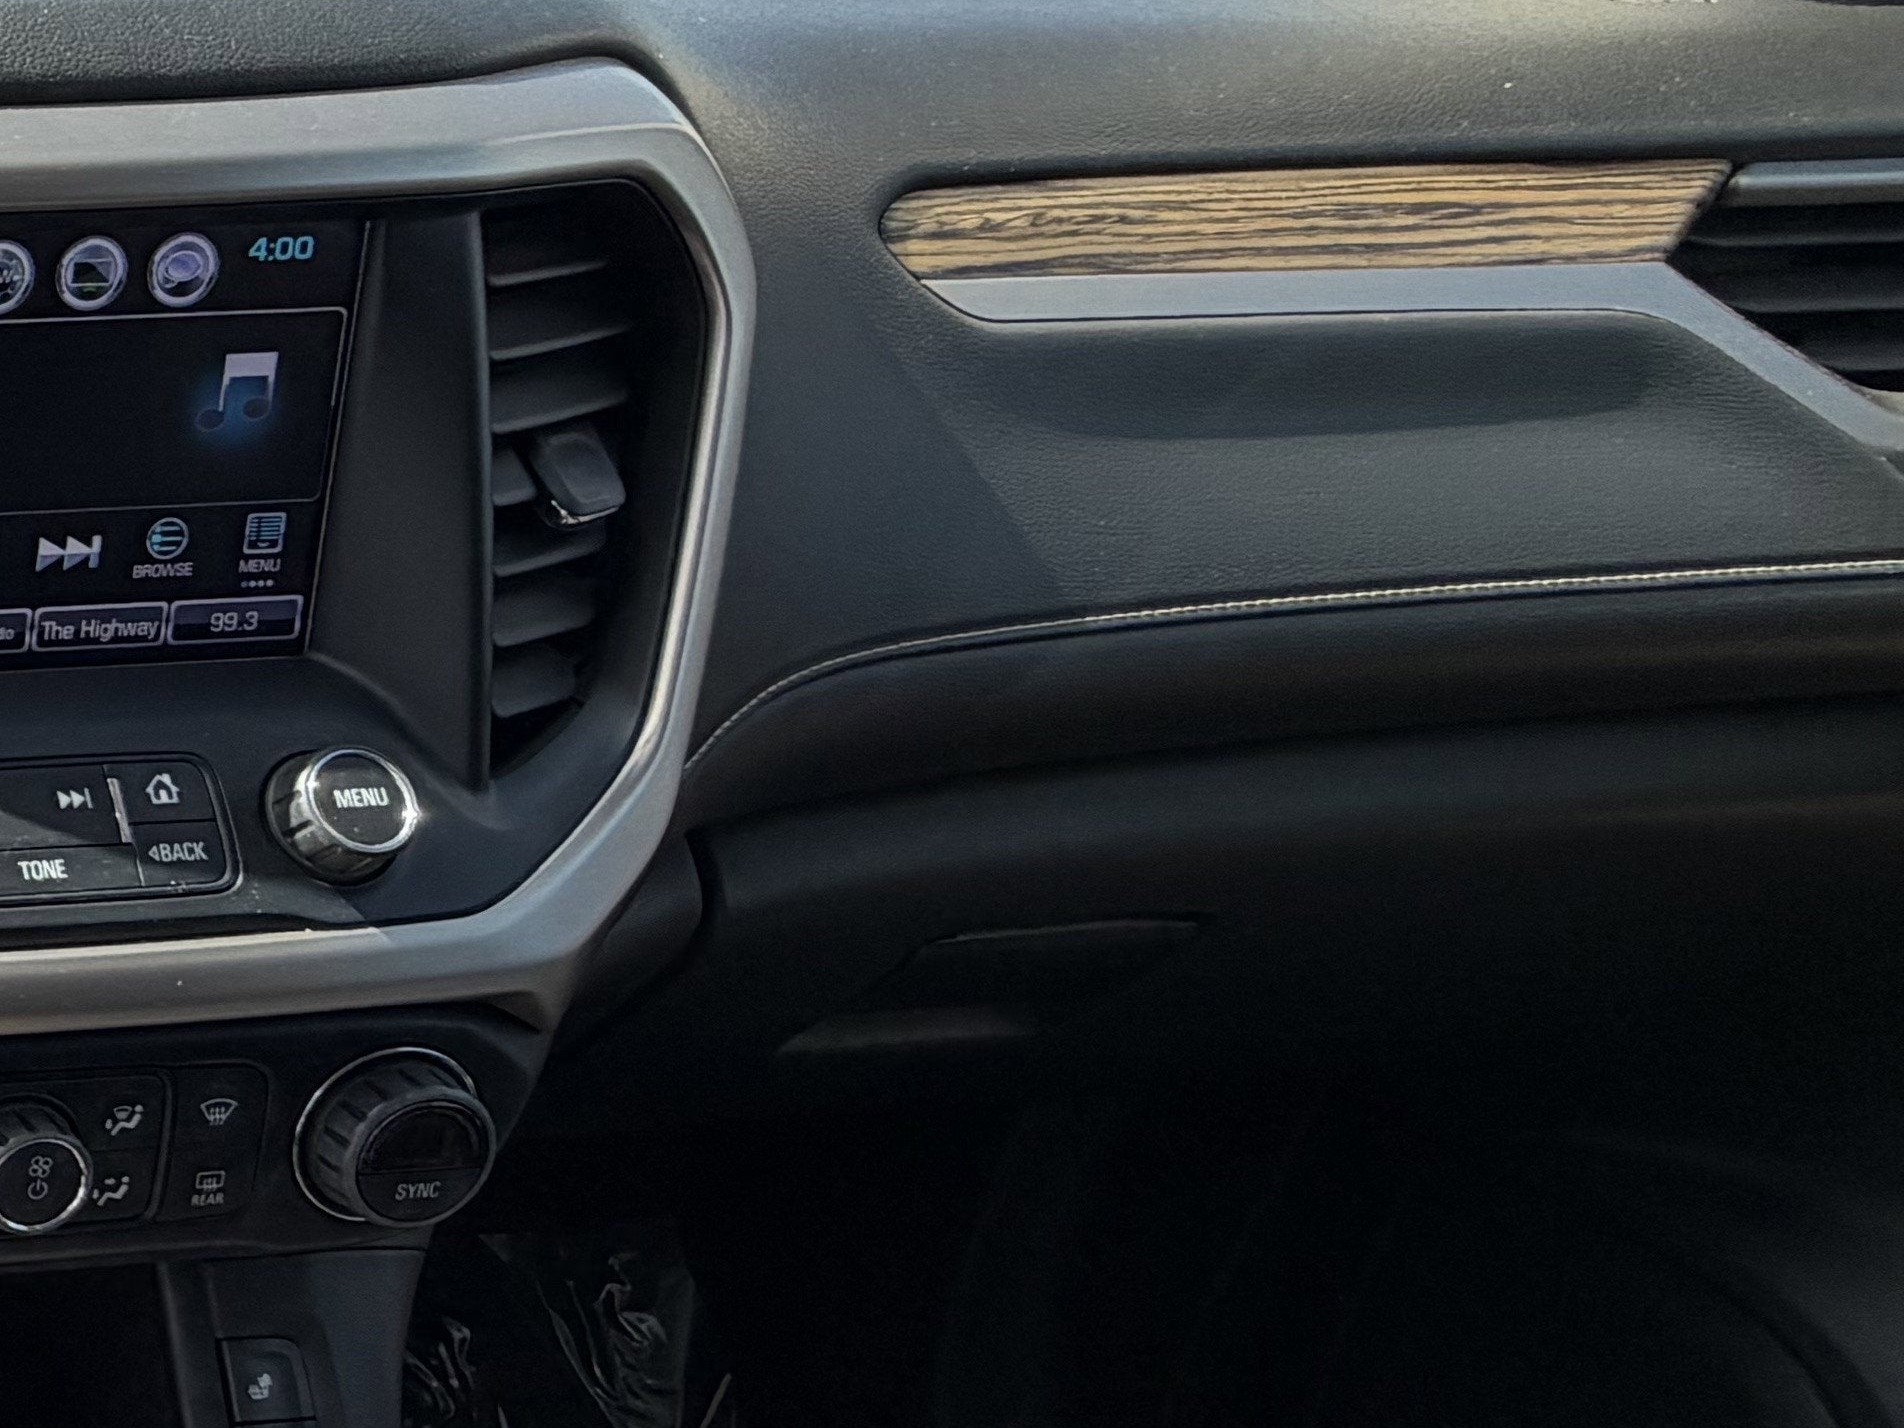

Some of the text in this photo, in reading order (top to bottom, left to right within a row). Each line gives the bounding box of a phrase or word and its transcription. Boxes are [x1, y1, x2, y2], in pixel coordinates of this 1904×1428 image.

[248, 236, 315, 262] 4:00
[132, 561, 194, 579] BROWSE
[238, 559, 281, 573] MENU
[41, 617, 160, 644] The Highway
[209, 611, 260, 633] 99.3
[332, 786, 390, 809] MENU
[159, 841, 209, 863] BACK
[17, 858, 69, 881] TONE
[192, 1191, 225, 1207] REAR
[394, 1180, 442, 1202] SYNC
